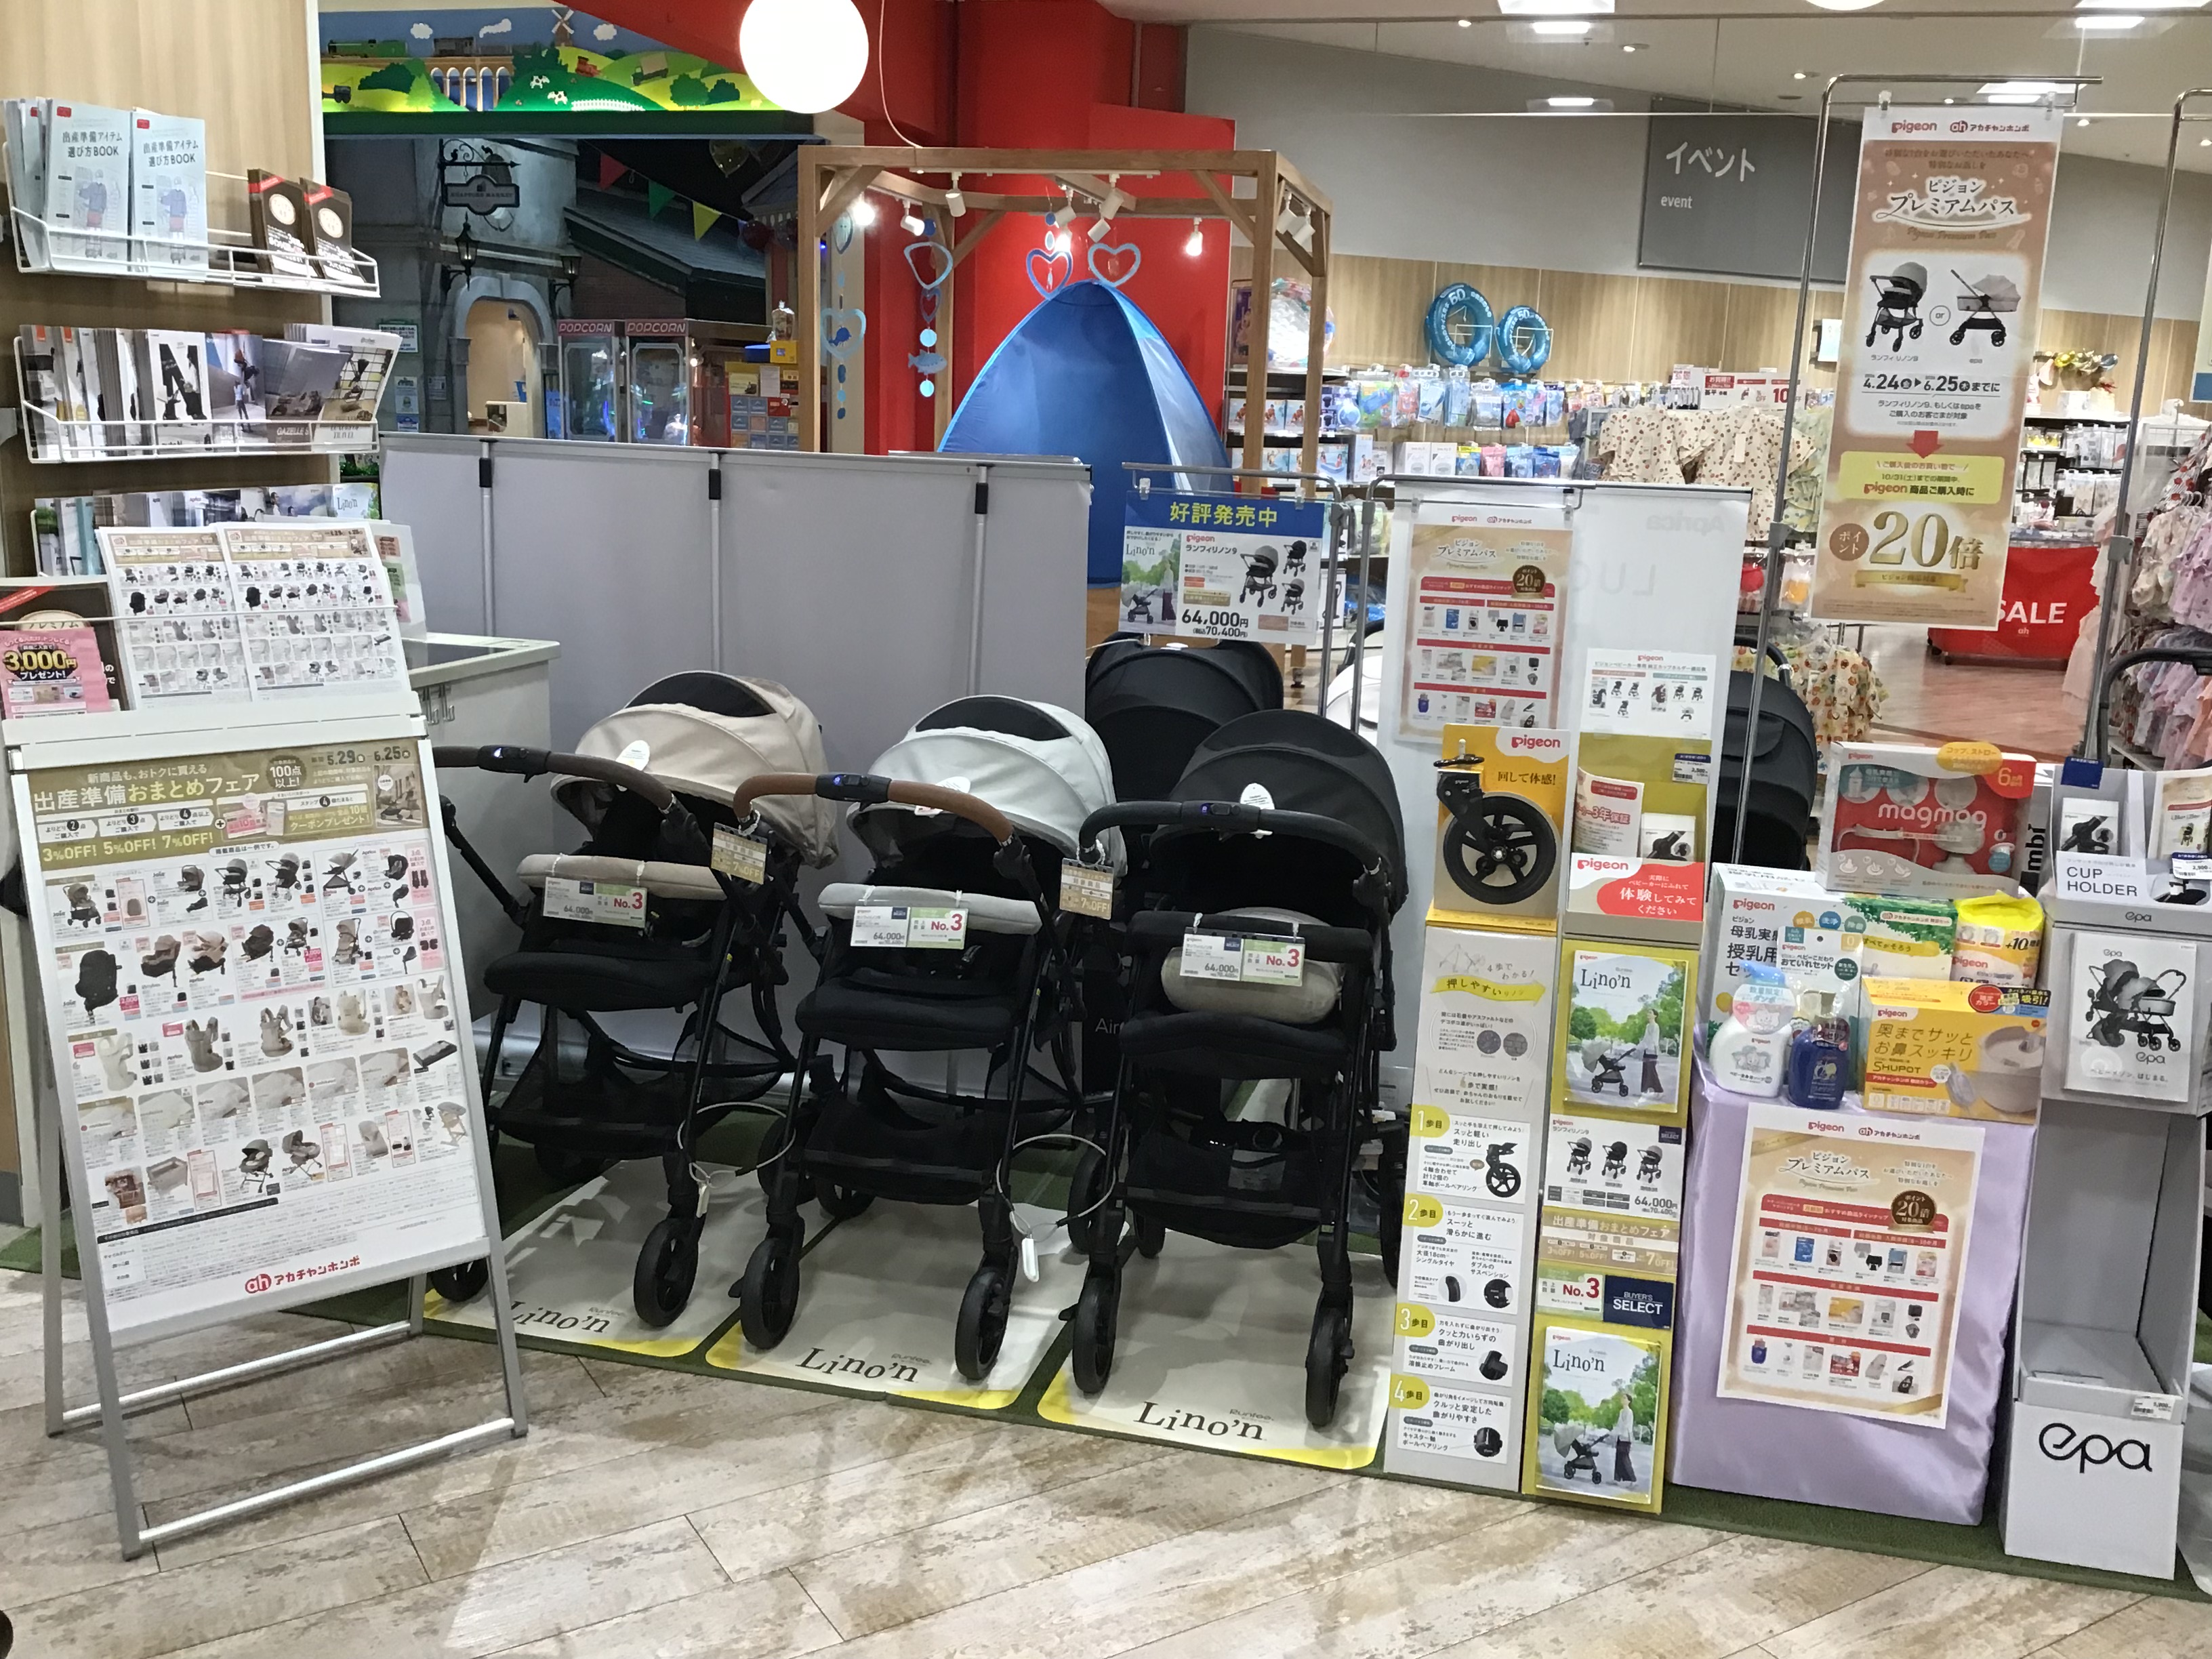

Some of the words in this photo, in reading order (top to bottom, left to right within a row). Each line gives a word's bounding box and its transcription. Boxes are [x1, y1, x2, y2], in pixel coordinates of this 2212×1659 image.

[1891, 120, 1937, 134] pigeon
[1969, 124, 2030, 133] アカチャンホンポ
[68, 146, 119, 157] 選び方BOOK
[148, 154, 196, 167] 選び方BOOK
[1665, 141, 1757, 182] イベント
[1929, 178, 1982, 194] ピジョン
[1660, 194, 1693, 210] event
[1891, 192, 2015, 215] プレミアムパス
[559, 323, 611, 333] POPCORN
[627, 322, 686, 332] POPCORN
[276, 427, 303, 436] GAZELLE
[1864, 482, 1908, 494] pigeon
[1170, 501, 1277, 528] 好評発売中
[1186, 534, 1215, 543] pigeon
[1126, 544, 1155, 556] Lino'n
[1185, 545, 1237, 554] ランフィリノン9
[1437, 546, 1496, 558] プレミアムパス
[1182, 609, 1249, 628] 64,000円
[20, 670, 66, 679] プレゼント!
[1511, 734, 1561, 750] pigeon
[87, 764, 207, 783] 新商品も、おトクに買える
[270, 765, 302, 778] 100点
[1498, 771, 1556, 786] 回して体感!
[34, 773, 260, 812] 出産準備おまとめフェア
[290, 815, 370, 832] クーポンプレゼント!
[1878, 803, 1987, 832] magmag
[104, 838, 156, 855] 5%OFF!
[161, 832, 213, 848] 7%OFF!
[43, 844, 97, 863] 3%OFF!
[1577, 858, 1629, 872] pigeon
[2067, 866, 2104, 879] CUP
[2067, 880, 2138, 897] HOLDER
[614, 892, 643, 909] No.3
[1619, 888, 1697, 906] 体験してみて
[1734, 899, 1775, 910] pigeon
[1637, 905, 1678, 916] ください
[2125, 912, 2152, 922] epa
[931, 914, 962, 931] No.3
[1267, 949, 1300, 967] No.3
[2104, 949, 2123, 958] epa
[1781, 959, 1834, 970] おていれセット
[1952, 956, 1988, 968] pigeon
[1580, 968, 1631, 990] Lino'n
[2022, 995, 2048, 1005] 吸引!
[1877, 1009, 1907, 1017] pigeon
[1876, 1023, 1973, 1046] 奥までサッと
[1874, 1041, 1973, 1061] お鼻スッキリ
[2136, 1051, 2165, 1065] epa
[1872, 1061, 1921, 1074] SHUPOT
[1417, 1111, 1442, 1131] 1歩目
[1454, 1129, 1489, 1138] スッと軽い
[1808, 1121, 1845, 1132] pigeon
[1874, 1130, 1921, 1141] アカチャンホンポ
[1453, 1139, 1482, 1148] 走り出し
[1812, 1152, 1849, 1164] ピジョン
[1788, 1158, 1870, 1179] プレミアムパス
[1408, 1199, 1436, 1221] 2歩目
[1446, 1228, 1492, 1241] 滑らかに進む
[1553, 1215, 1671, 1238] 出産準備おまとめフェア
[274, 1256, 361, 1286] アカチャンホンポ
[1563, 1277, 1600, 1298] No.3
[1613, 1298, 1663, 1315] SELECT
[1400, 1308, 1428, 1330] 3歩目
[1438, 1328, 1496, 1343] クッと力いらずの
[1438, 1339, 1475, 1350] 曲がり出し
[796, 1347, 919, 1382] Lino'n
[1553, 1349, 1605, 1372] Lino'n
[1394, 1380, 1423, 1402] 4歩目
[1433, 1400, 1492, 1416] クルッと安定した
[1134, 1401, 1267, 1441] Lino'n
[1433, 1411, 1477, 1424] 曲がりやすさ
[2039, 1422, 2152, 1474] epa
